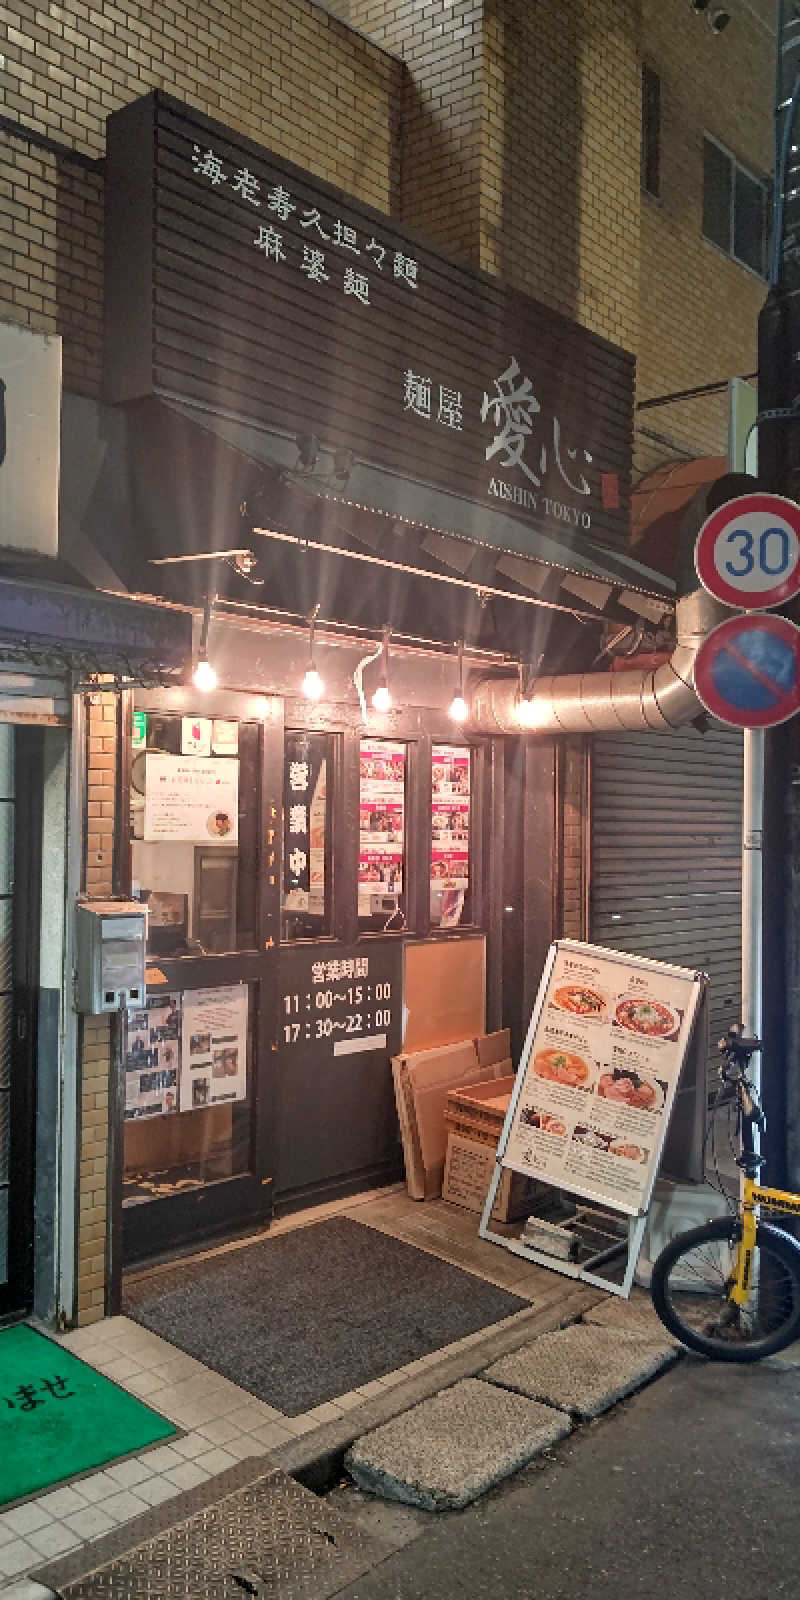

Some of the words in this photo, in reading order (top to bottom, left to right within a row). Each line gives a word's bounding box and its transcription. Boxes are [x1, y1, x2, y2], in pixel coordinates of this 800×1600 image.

[191, 143, 418, 289] 海老寿久担々麺
[253, 225, 371, 305] 麻婆麺
[403, 369, 463, 431] 麺屋
[487, 476, 538, 509] AISHIN
[542, 497, 592, 529] TOKYO
[725, 527, 790, 577] 30
[288, 760, 312, 876] 営業中
[311, 957, 369, 985] 営業時間
